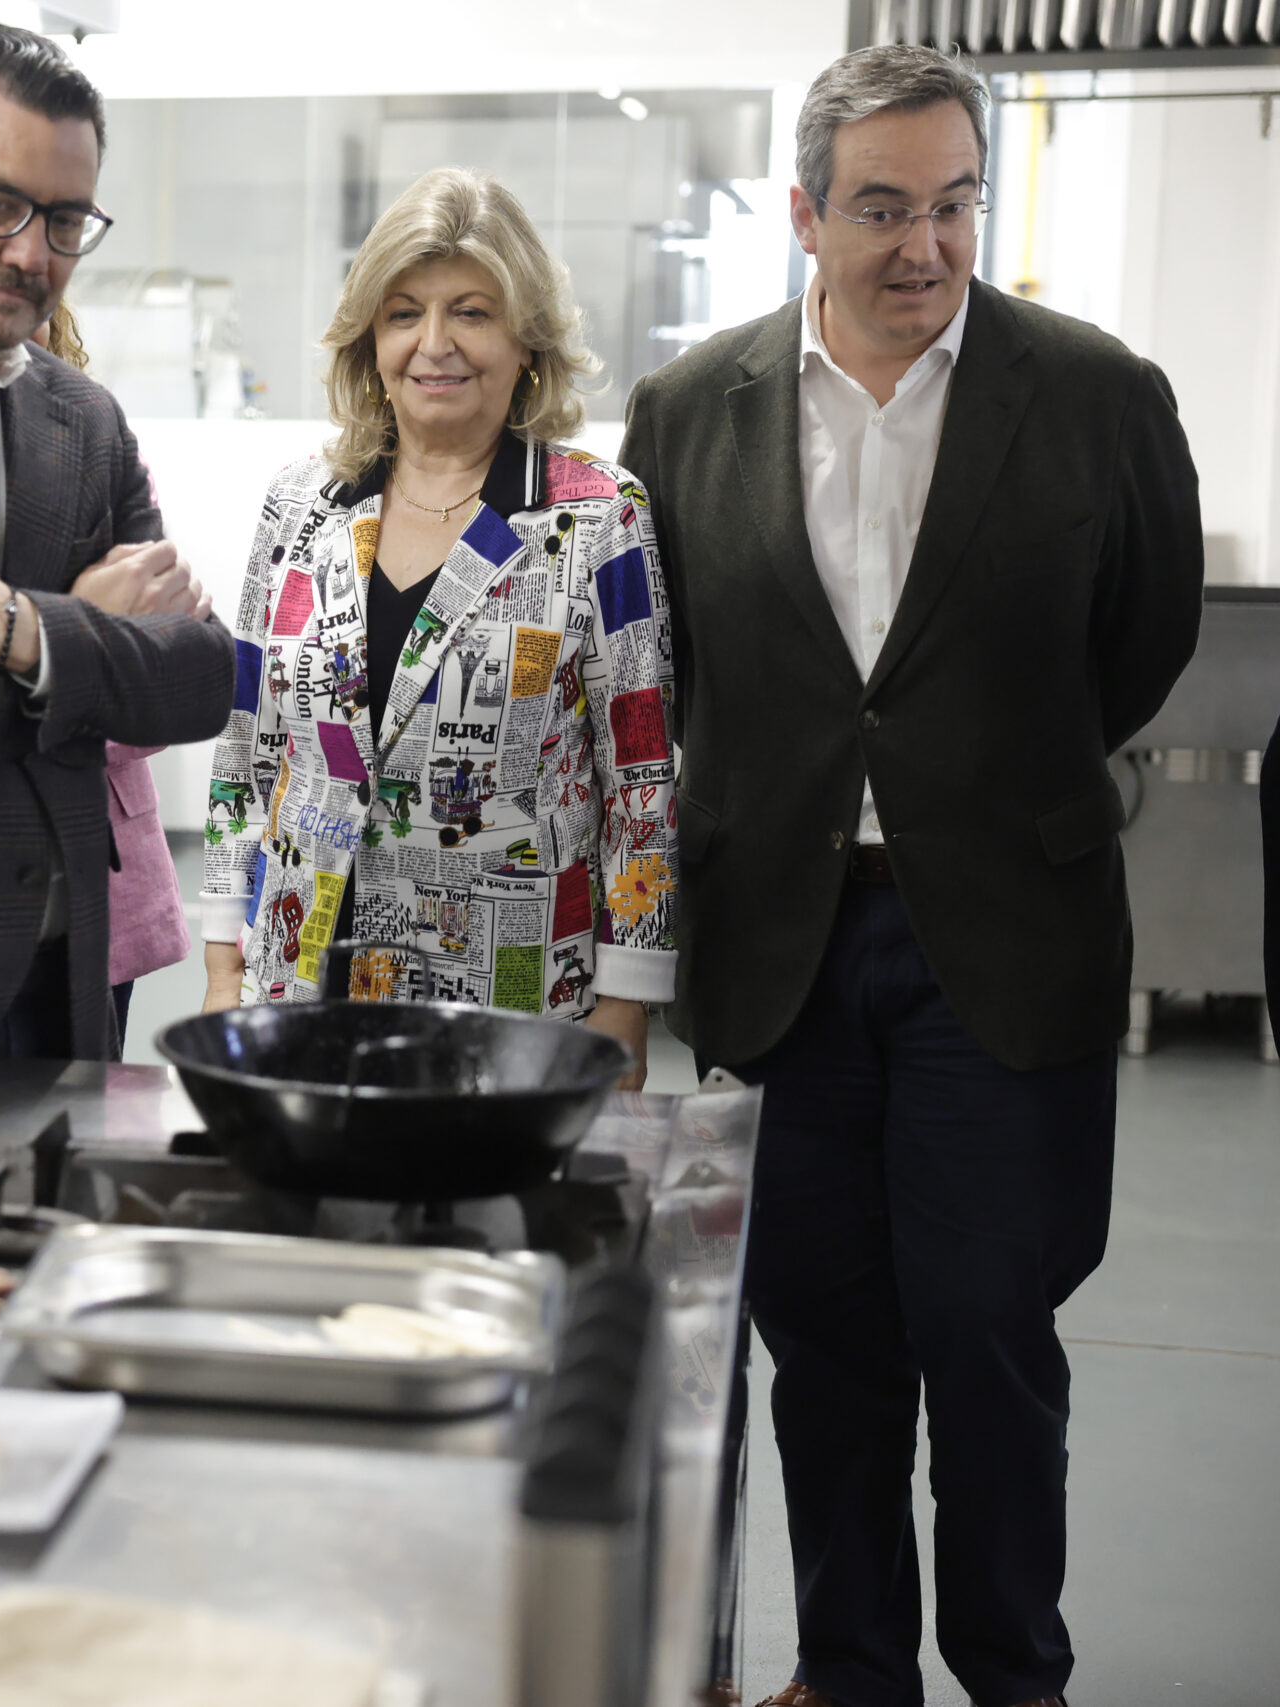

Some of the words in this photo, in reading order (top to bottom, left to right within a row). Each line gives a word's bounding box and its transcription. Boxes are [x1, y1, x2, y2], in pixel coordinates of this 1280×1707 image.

[289, 509, 327, 562] Paris
[554, 548, 567, 593] Travel
[296, 642, 320, 719] London
[438, 722, 497, 745] Paris
[624, 769, 641, 782] The
[297, 805, 361, 854] ASHION
[414, 884, 442, 899] New
[486, 878, 511, 891] York
[513, 882, 536, 892] New
